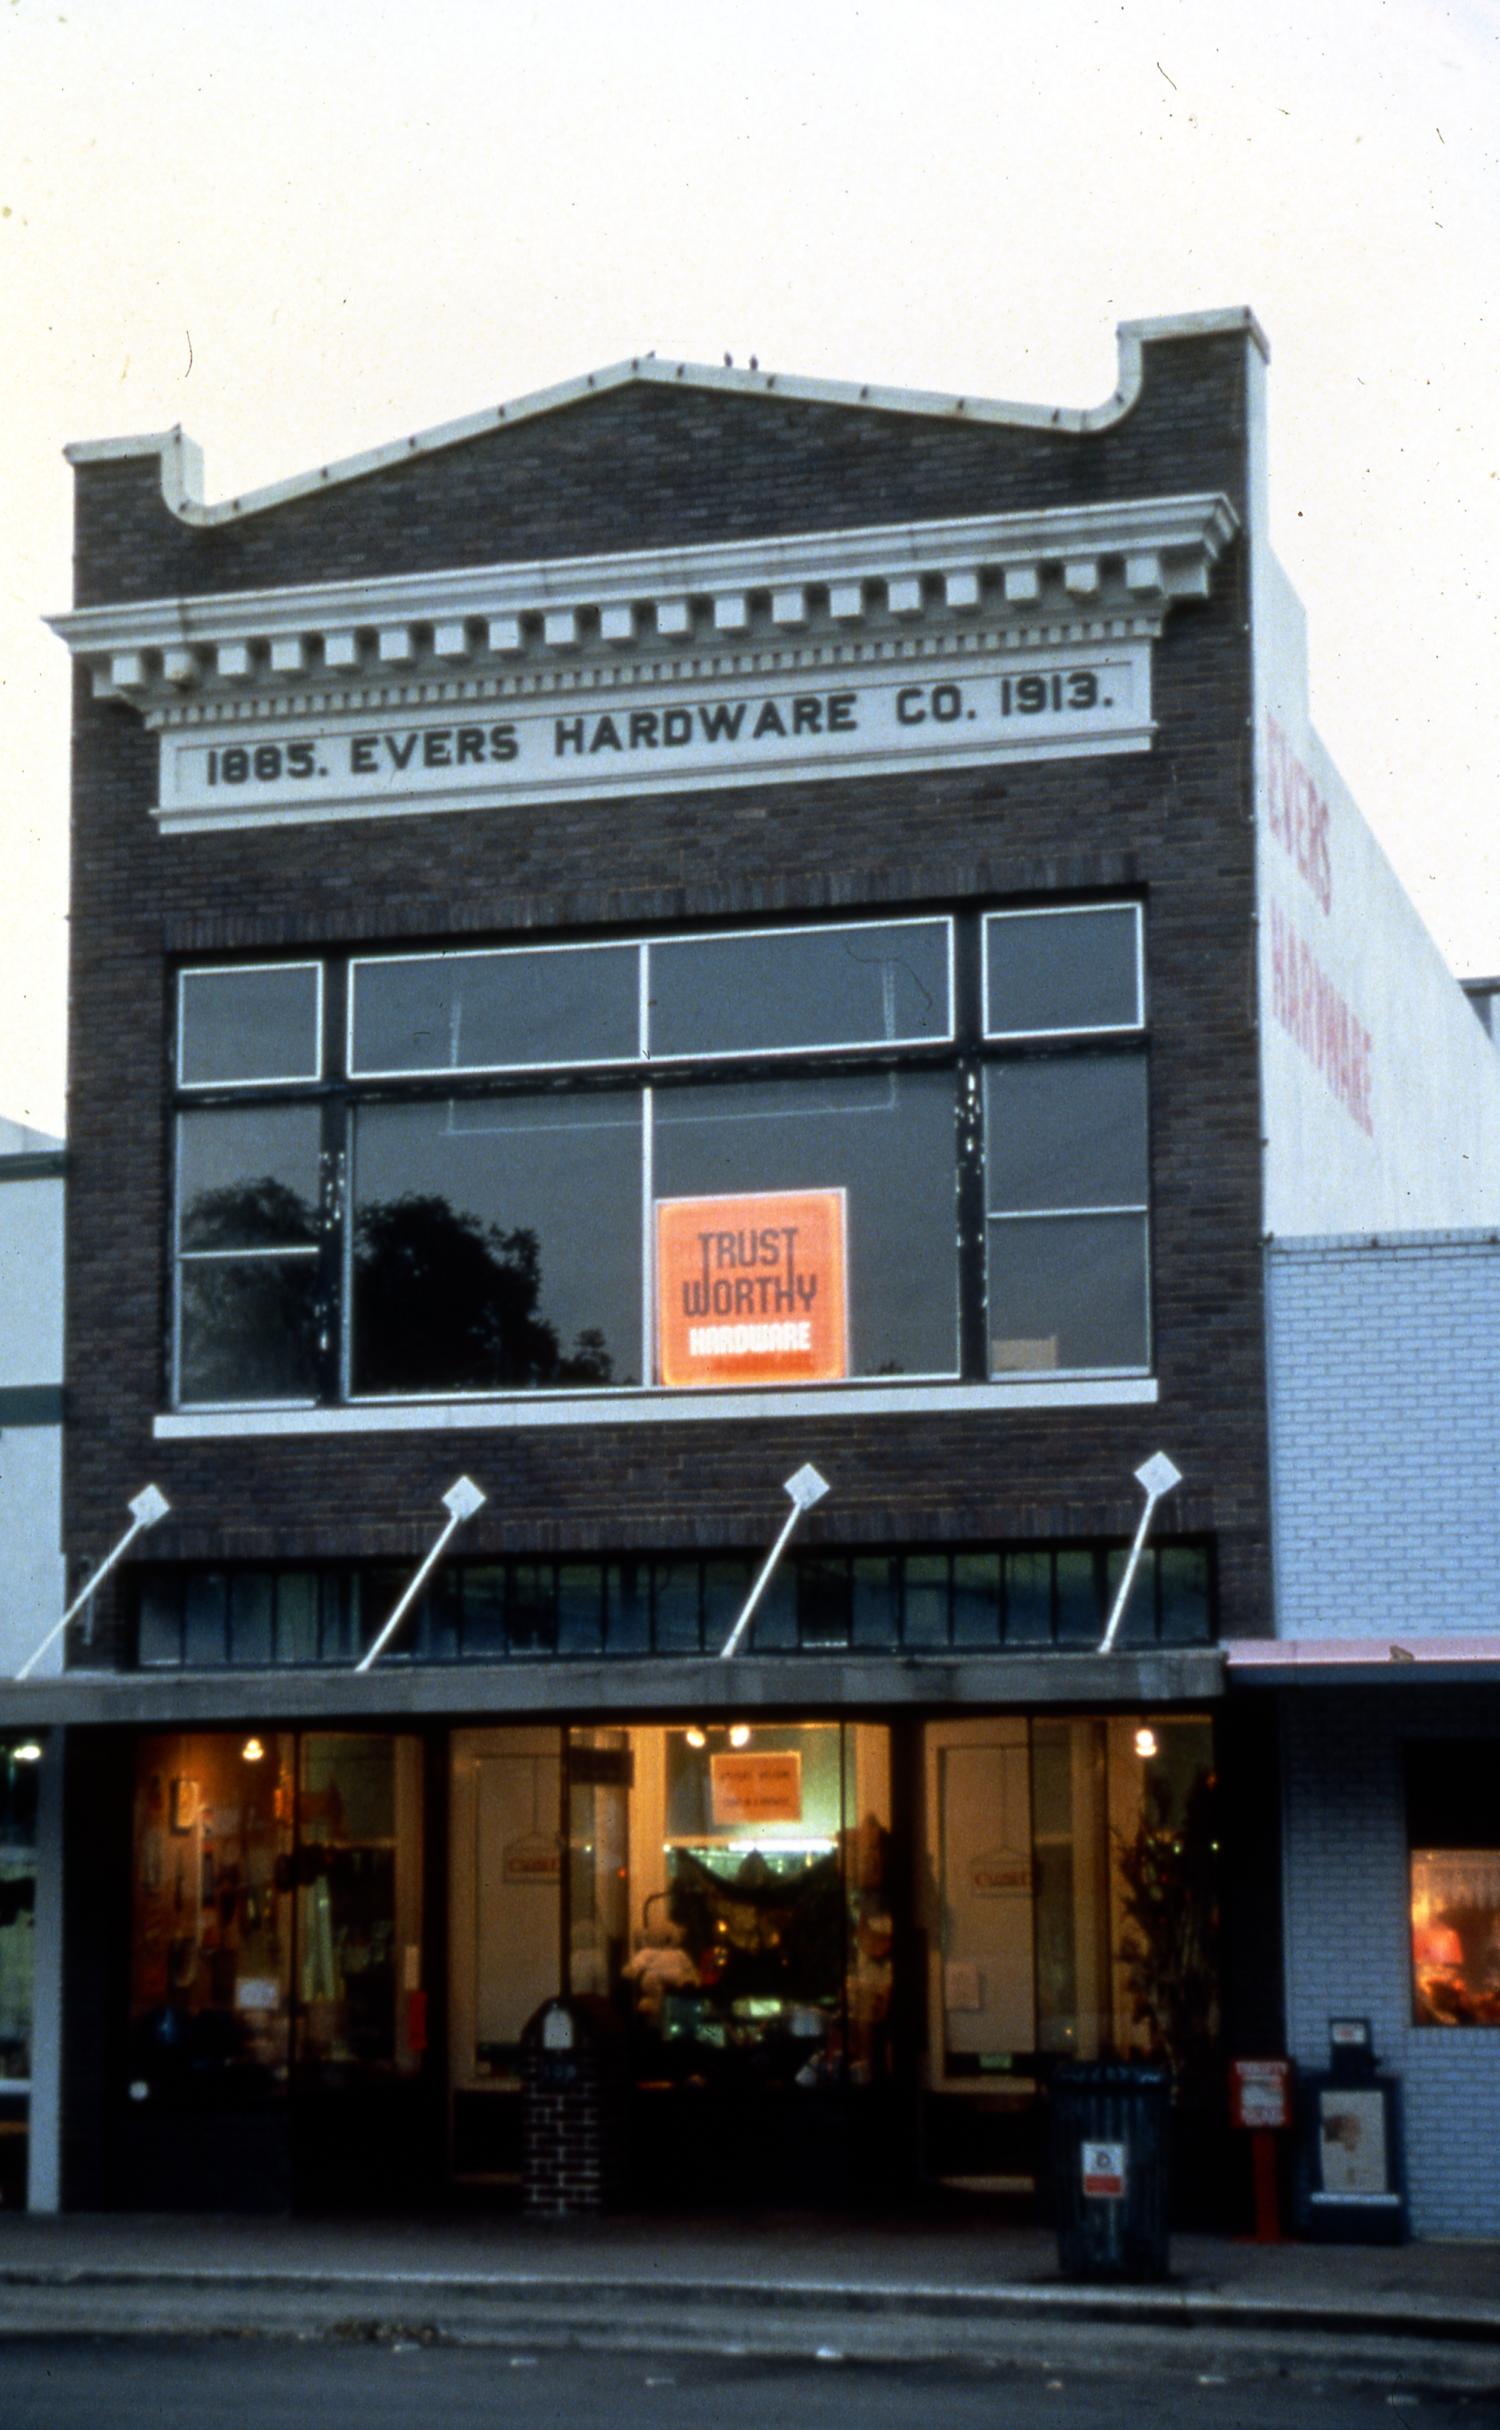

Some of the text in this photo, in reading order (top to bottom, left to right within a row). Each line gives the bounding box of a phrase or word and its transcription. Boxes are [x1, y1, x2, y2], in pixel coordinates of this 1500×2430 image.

[207, 671, 1114, 786] 1885. EVERS HARDWARE CO. 1913.
[698, 1227, 798, 1270] TRUST
[682, 1273, 818, 1318] WORTHY
[688, 1320, 812, 1357] HARDWARE
